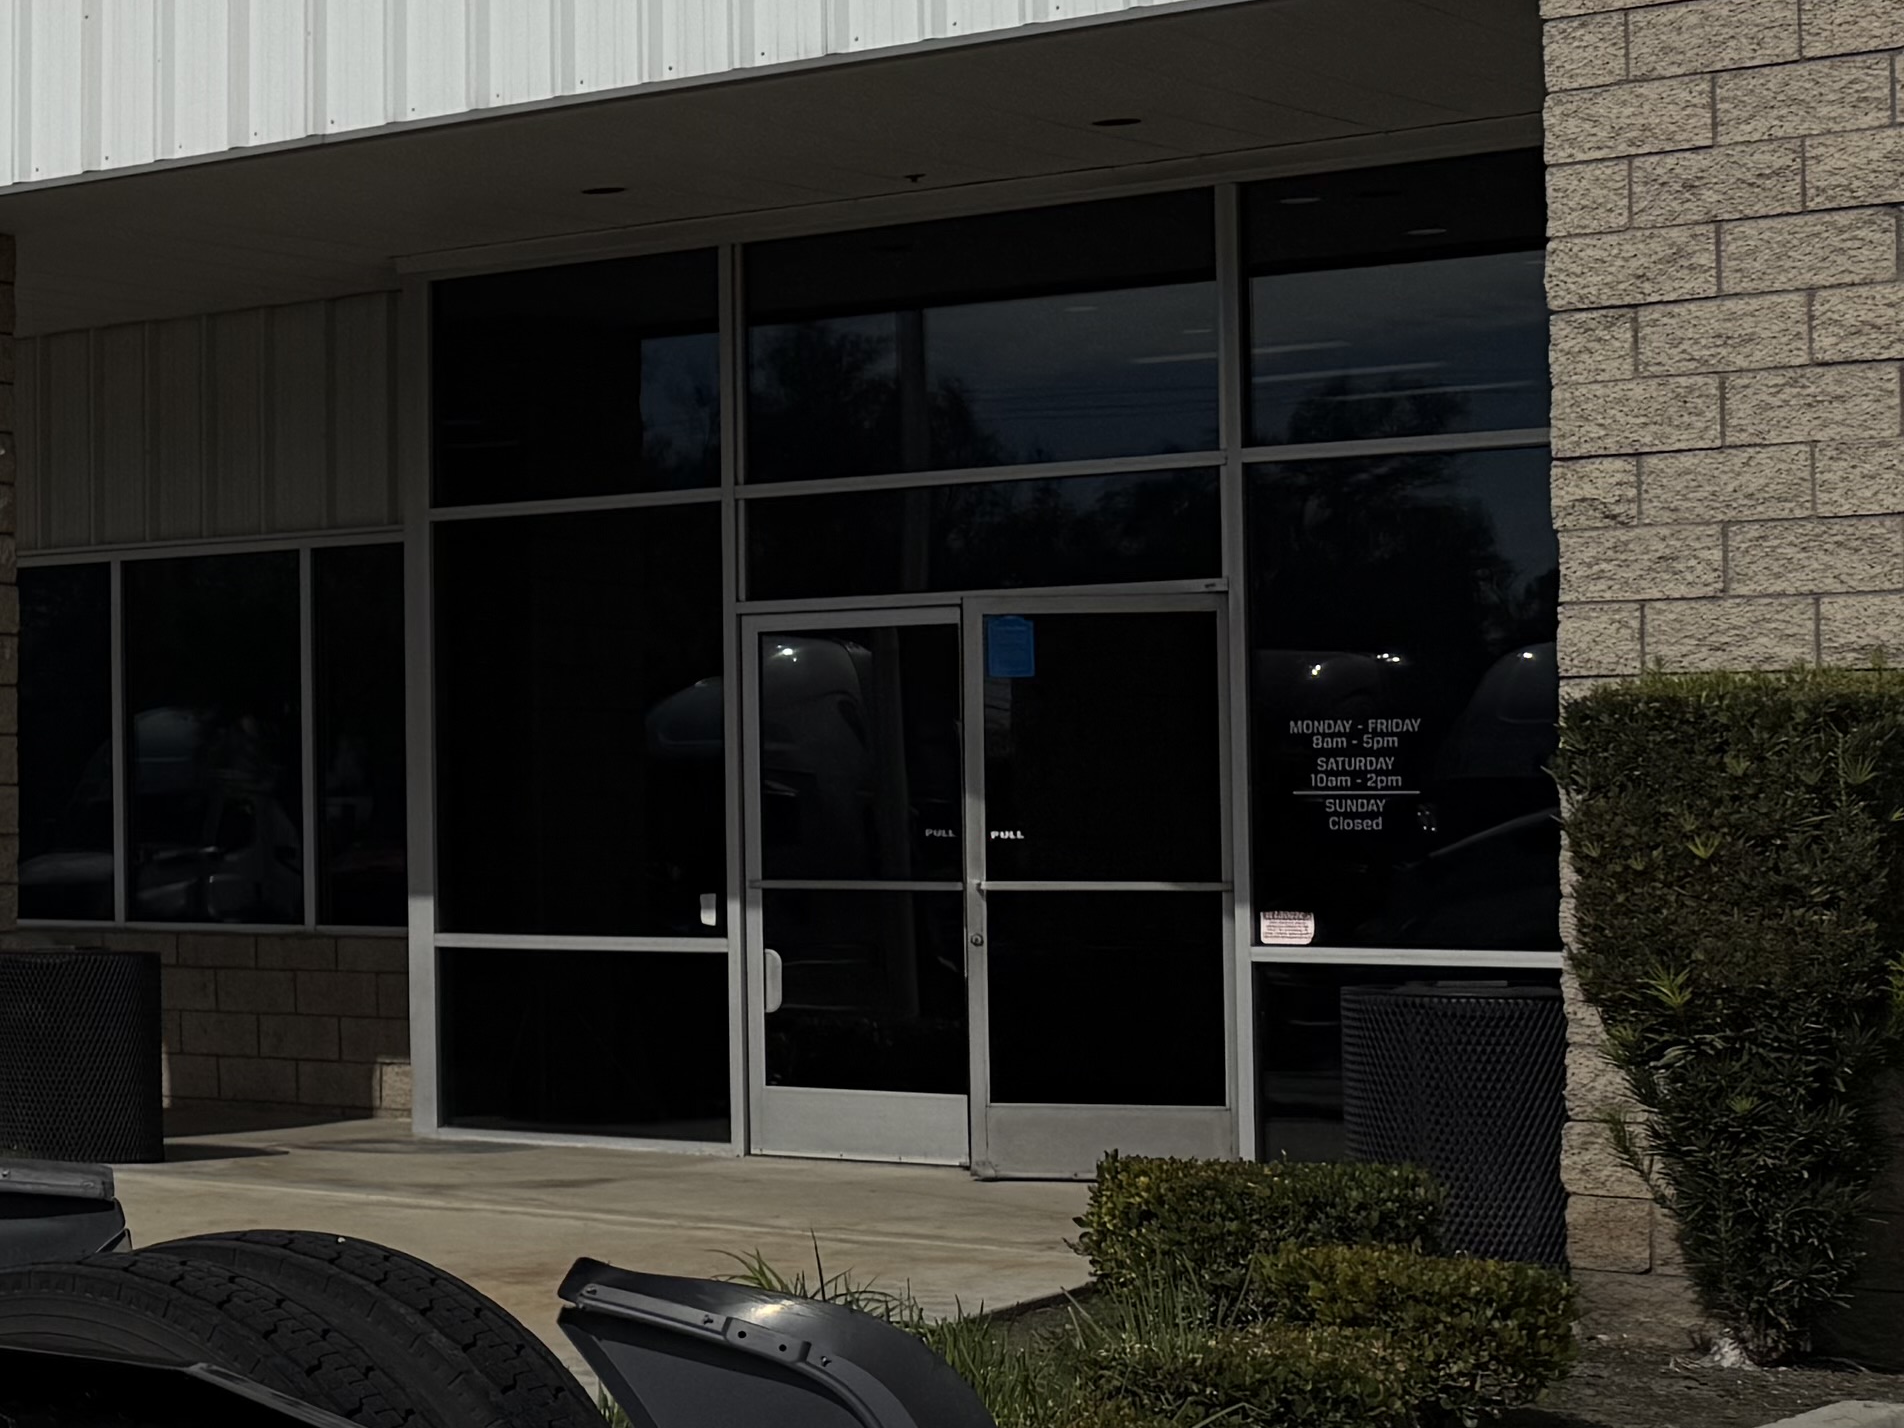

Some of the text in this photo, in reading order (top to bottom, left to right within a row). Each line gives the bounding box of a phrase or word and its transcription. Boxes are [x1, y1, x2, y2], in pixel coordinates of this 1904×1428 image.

[1289, 719, 1353, 734] MONDAY
[1368, 717, 1422, 733] FRIDAY
[1312, 735, 1347, 749] 8am
[1362, 735, 1399, 750] 5pm
[1316, 756, 1395, 771] SATURDAY
[1310, 773, 1351, 788] 10am
[1366, 773, 1402, 790] 2pm
[1325, 798, 1386, 813] SUNDAY
[1328, 815, 1383, 831] Closed
[924, 828, 958, 838] PULL
[989, 830, 1025, 840] PULL
